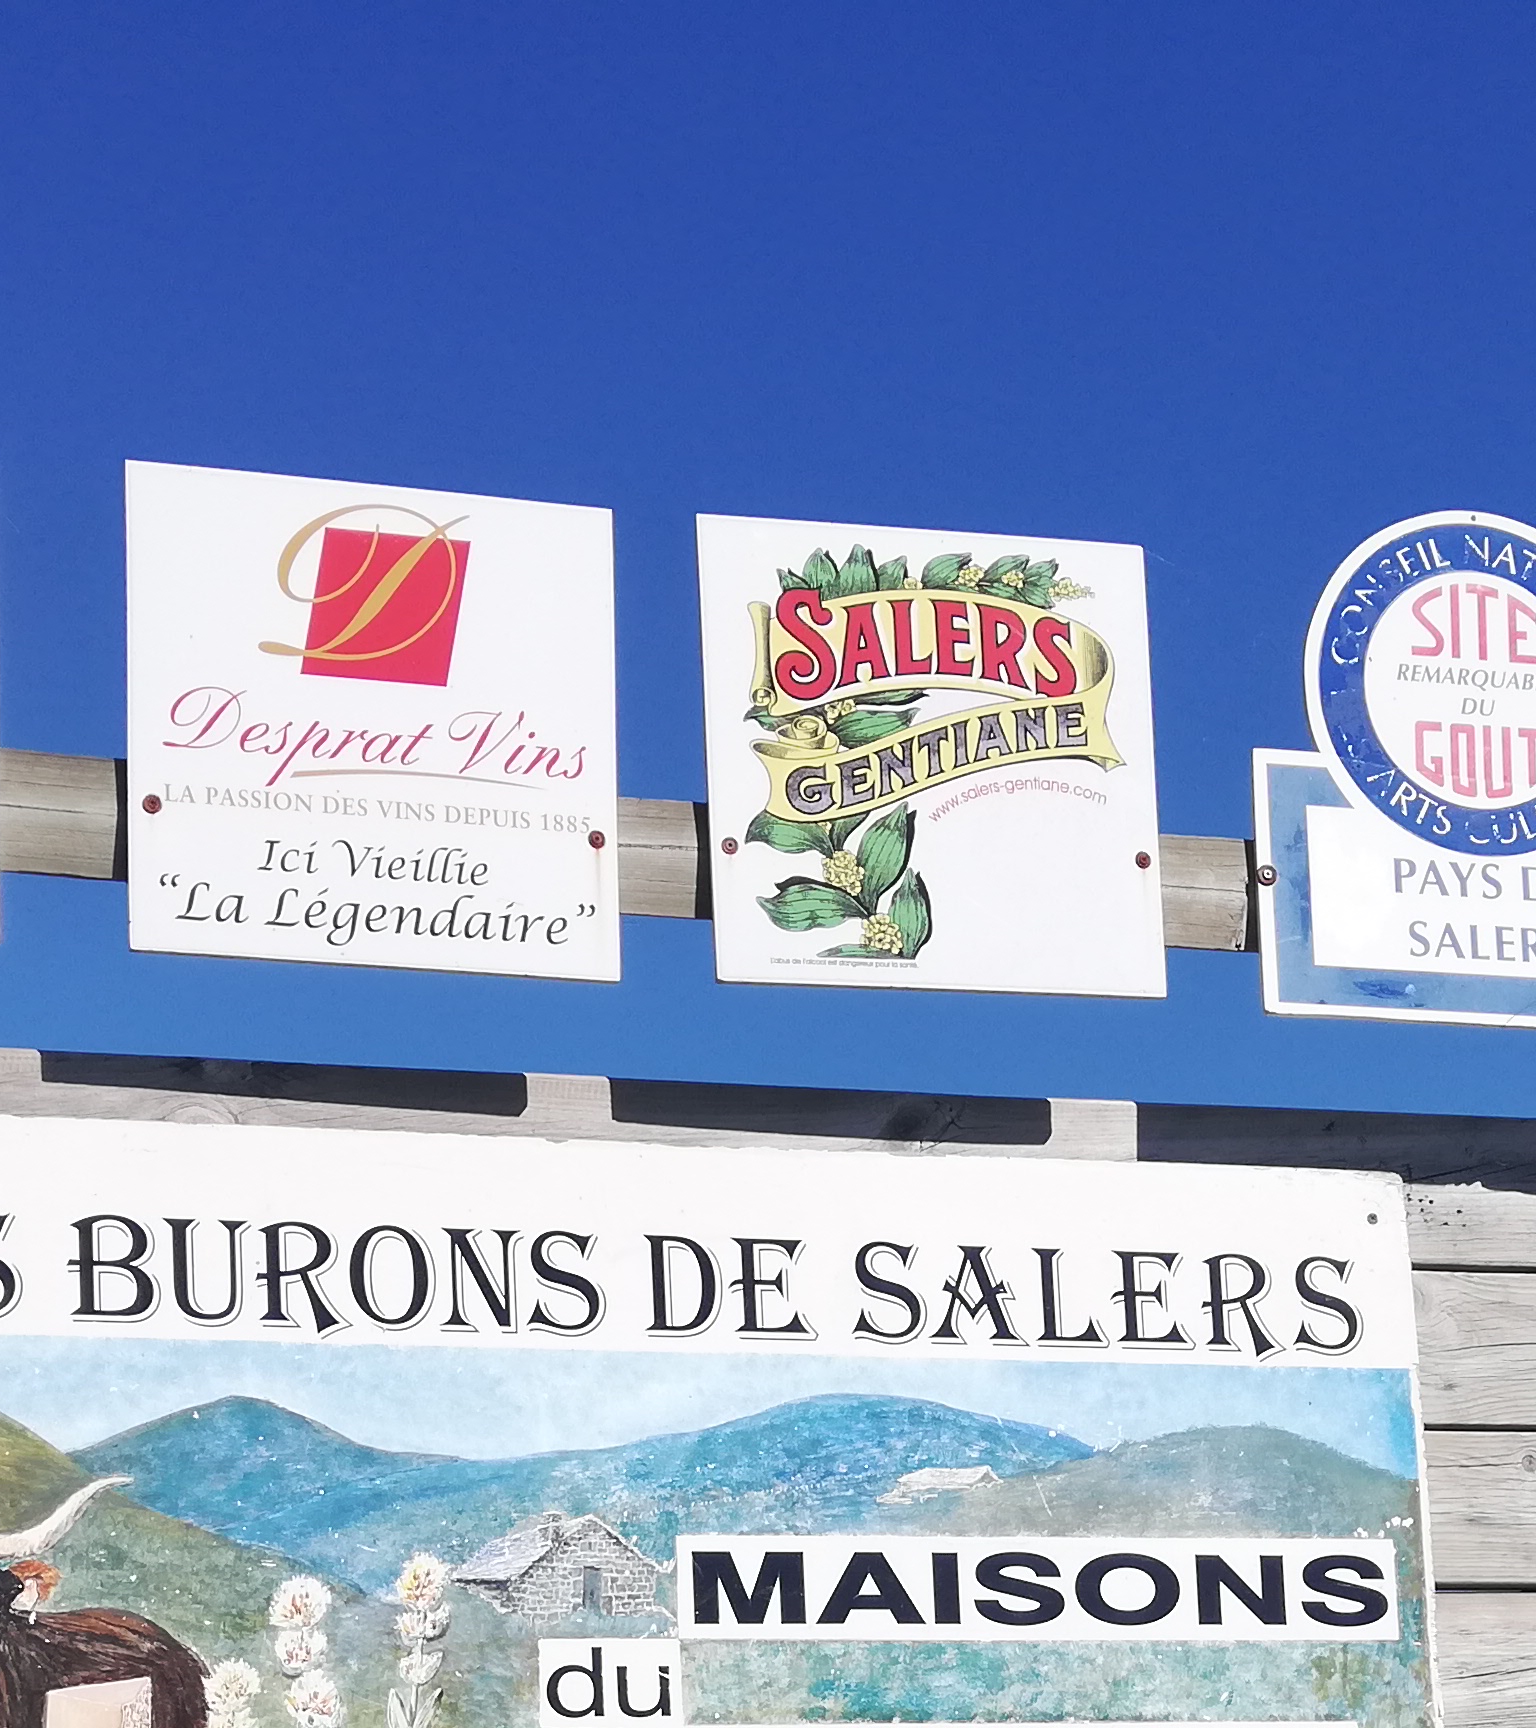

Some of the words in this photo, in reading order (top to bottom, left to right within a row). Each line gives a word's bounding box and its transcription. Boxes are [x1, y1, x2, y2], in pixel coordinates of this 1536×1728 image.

[774, 588, 1077, 700] SALERS
[162, 686, 433, 786] Desprat
[448, 710, 586, 780] Vins
[1460, 697, 1496, 716] DU
[785, 702, 1088, 815] GENTIANE
[164, 783, 195, 804] LA
[205, 786, 313, 814] PASSION
[322, 796, 368, 817] DES
[376, 800, 435, 822] VINS
[444, 804, 531, 829] DEPUIS
[541, 813, 591, 834] 1885
[928, 777, 1107, 822] www.salers-gentiane.com
[1367, 768, 1452, 834] ARTS
[257, 839, 319, 873] Ici
[331, 839, 489, 886] Vieillie
[1393, 858, 1502, 900] PAYS
[68, 1213, 606, 1337] BURONS
[643, 1232, 817, 1340] DE
[854, 1238, 1369, 1362] SALERS
[692, 1550, 1389, 1627] MAISONS
[544, 1647, 672, 1720] du
